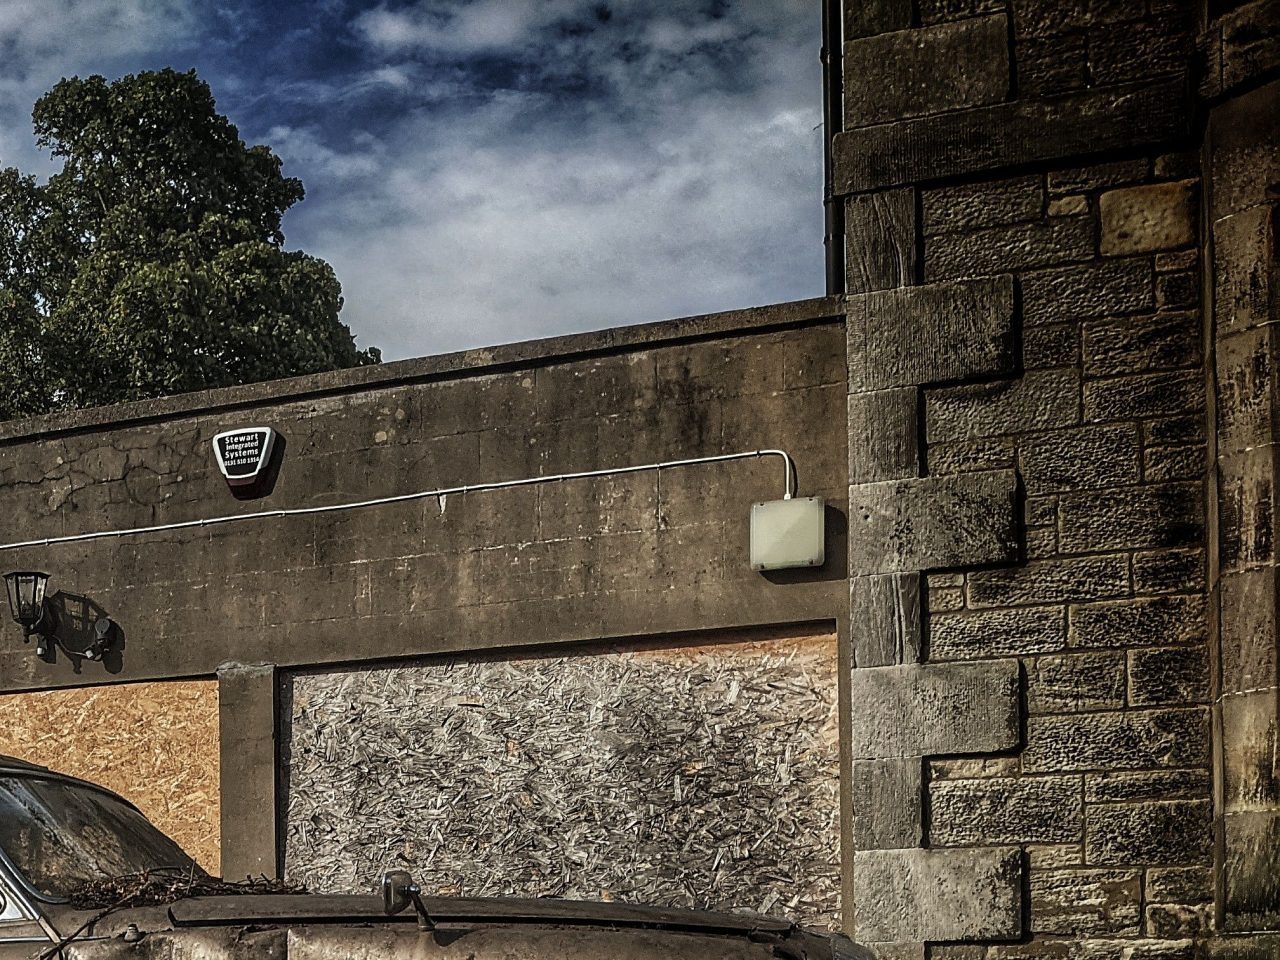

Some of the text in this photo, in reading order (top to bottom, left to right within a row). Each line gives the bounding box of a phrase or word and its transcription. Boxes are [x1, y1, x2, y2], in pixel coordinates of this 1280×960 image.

[225, 433, 258, 444] Stewart
[226, 440, 258, 450] Integrated
[225, 449, 258, 459] Systems
